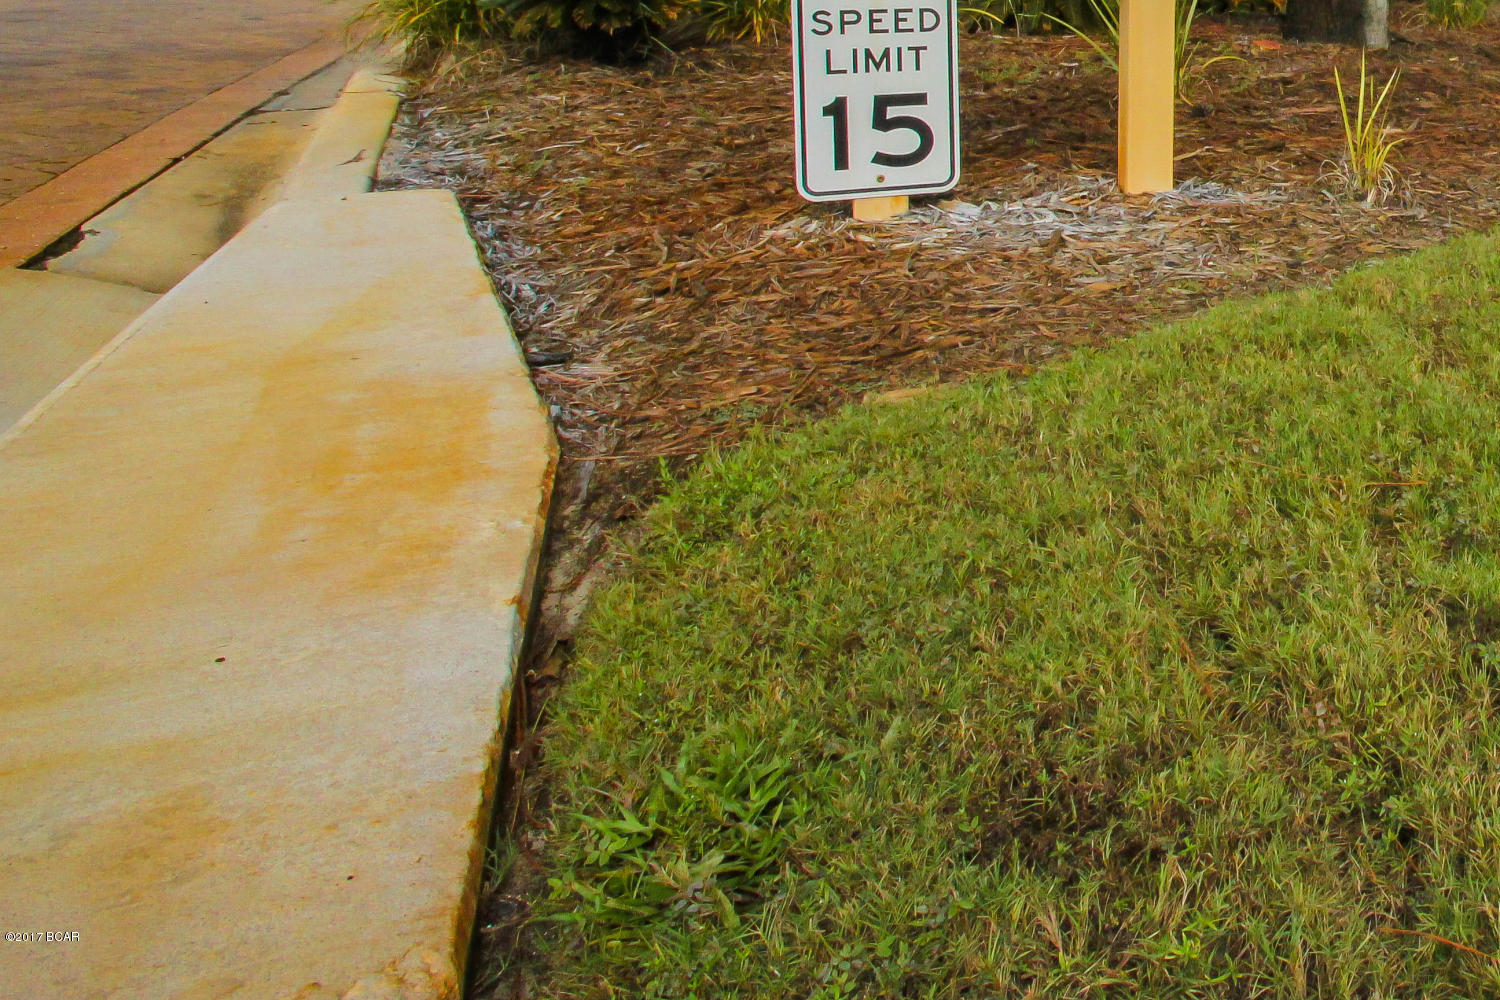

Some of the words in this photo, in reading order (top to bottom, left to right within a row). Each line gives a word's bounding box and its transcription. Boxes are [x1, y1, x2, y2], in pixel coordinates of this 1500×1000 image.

[811, 8, 941, 36] SPEED
[825, 45, 928, 75] LIMIT
[822, 92, 935, 171] 15
